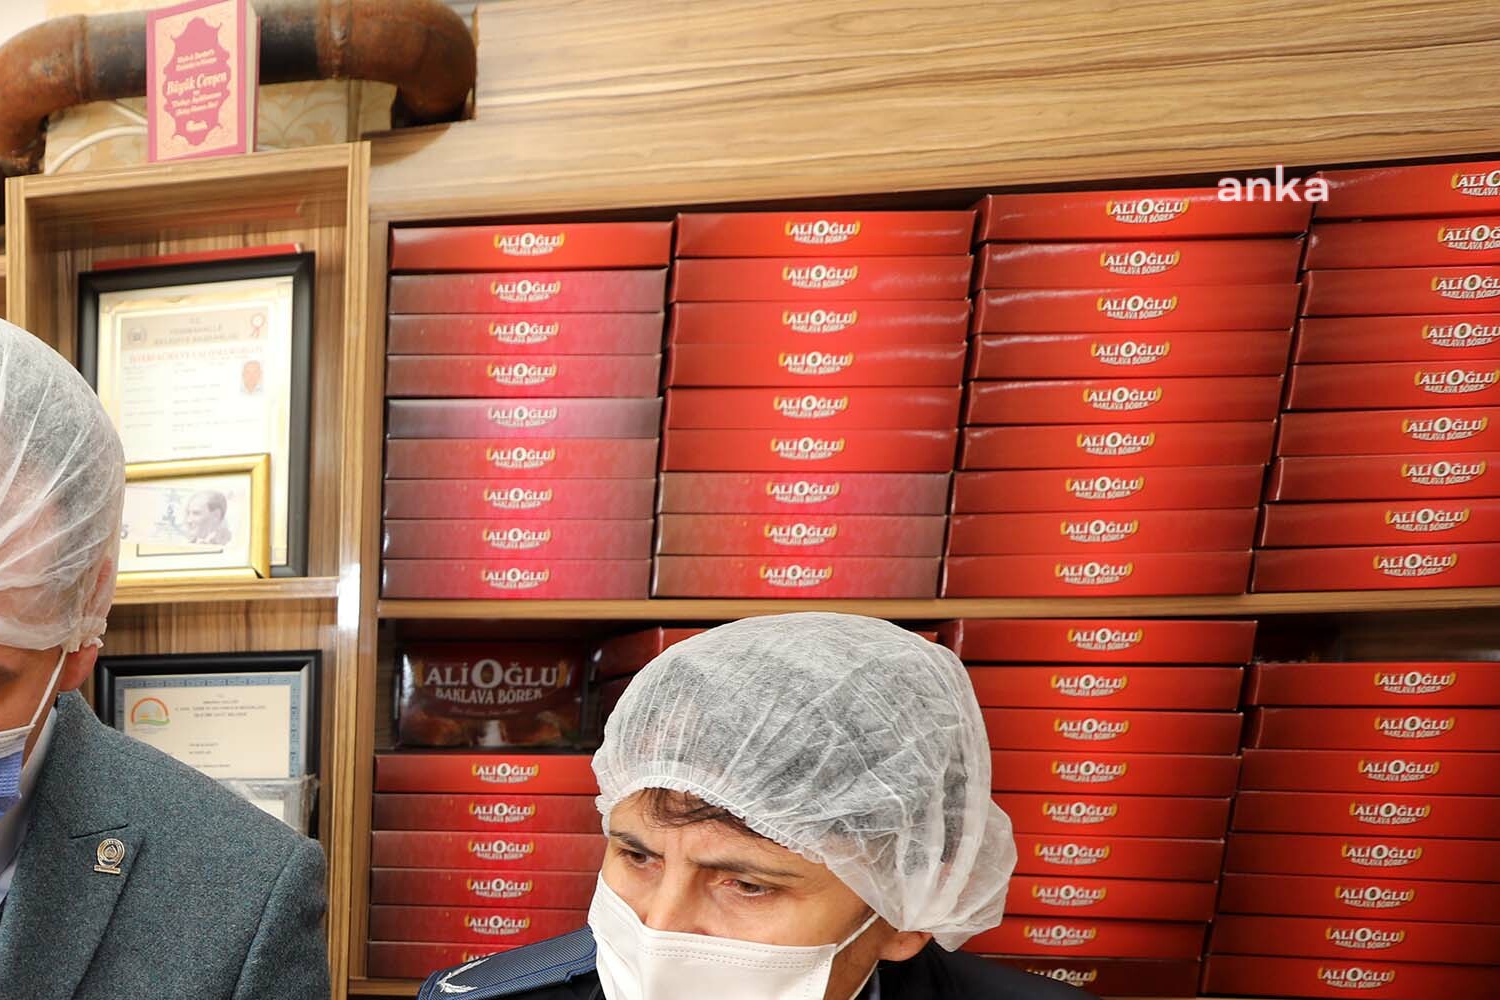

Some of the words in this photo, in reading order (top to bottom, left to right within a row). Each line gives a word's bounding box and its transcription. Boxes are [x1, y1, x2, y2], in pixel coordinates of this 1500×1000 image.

[1458, 170, 1500, 187] ALİO
[1110, 199, 1180, 214] ALİOĞLU
[1445, 225, 1500, 241] ALİOĞ
[1105, 252, 1174, 267] ALİOĞLU
[1438, 275, 1500, 290] ALİOĞL
[1102, 296, 1171, 311] ALİOĞLU
[1096, 342, 1165, 357] ALİOĞLU
[1421, 369, 1495, 385] ALİOĞLU
[1089, 388, 1156, 403] ALİOĞLU
[1408, 417, 1481, 432] ALİOĞLU
[1082, 433, 1149, 448] ALİOĞLU
[1408, 461, 1480, 476] ALİOĞLU
[1071, 477, 1138, 492] ALİOĞLU
[1392, 508, 1464, 523] ALİOĞLU
[1066, 520, 1133, 535] ALİOĞLU
[1380, 554, 1449, 568] ALİOĞLU
[1061, 563, 1126, 578] ALİOĞLU
[424, 659, 558, 688] ALİOĞLU
[1380, 672, 1450, 686] ALİOĞLU
[436, 687, 495, 704] BAKLAVA
[499, 686, 542, 704] BÖREK
[1379, 717, 1448, 731] ALİOĞLU
[1364, 760, 1434, 774] ALİOĞLU
[1354, 803, 1425, 817] ALİOĞLU
[1346, 845, 1417, 859] ALİOĞLU
[1340, 887, 1409, 901] ALİOĞLU
[1330, 928, 1399, 942] ALİOĞLU
[1322, 968, 1390, 982] ALİOĞLU
